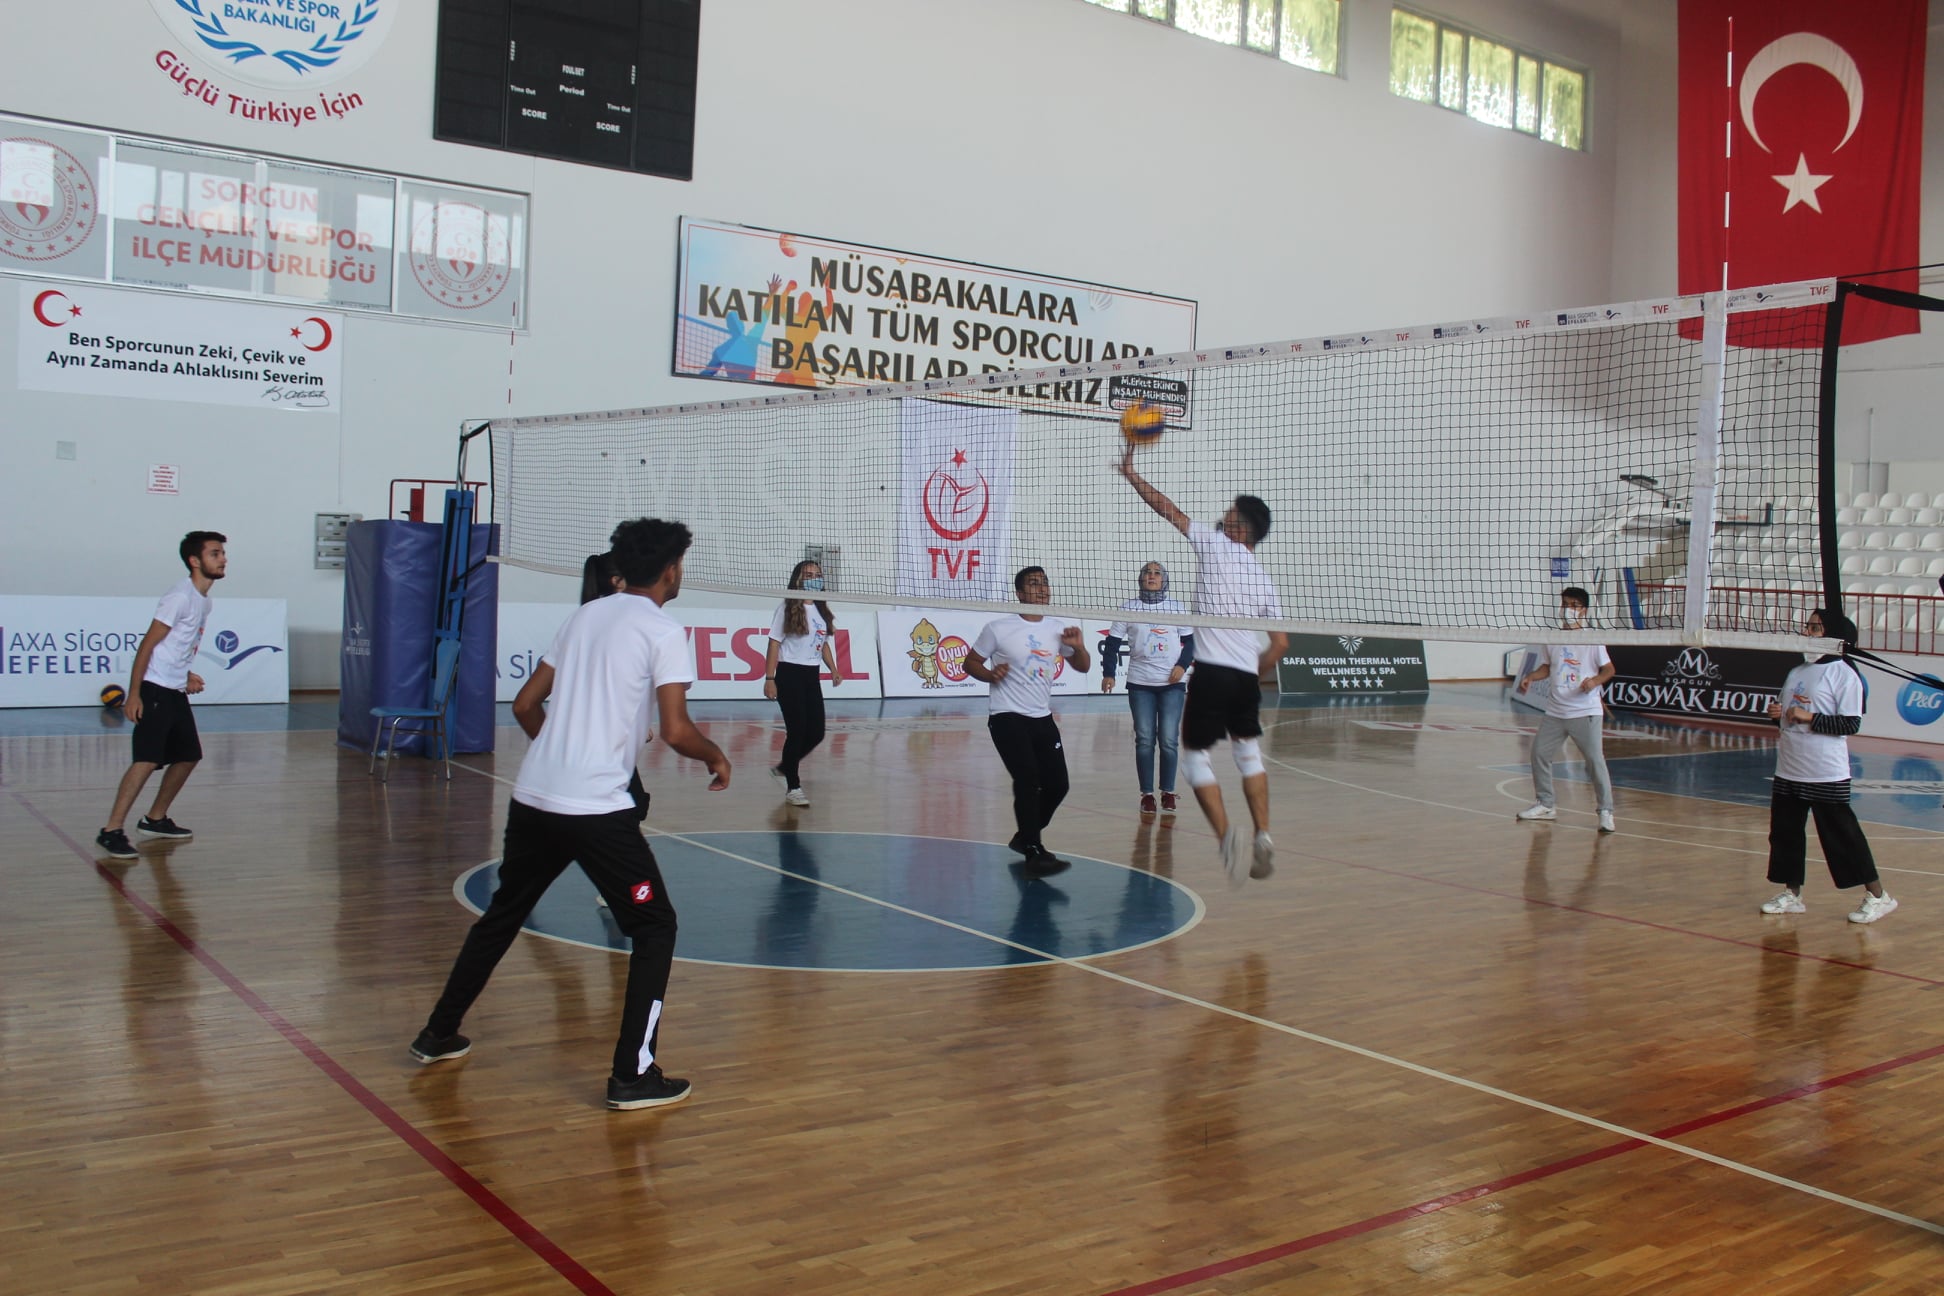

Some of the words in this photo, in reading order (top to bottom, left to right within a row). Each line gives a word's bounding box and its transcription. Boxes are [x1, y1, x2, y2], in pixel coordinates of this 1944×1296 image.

[224, 4, 315, 33] BAKANLIĞI
[298, 0, 340, 20] SPOR
[155, 50, 220, 106] Güçlü
[228, 94, 317, 127] Türkiye
[319, 92, 363, 119] İçin
[559, 84, 585, 96] Period
[522, 108, 547, 120] SCORE
[596, 122, 620, 133] SCORE
[201, 178, 318, 212] SORGUN
[137, 203, 257, 239] GENÇLİK
[266, 218, 298, 243] VE
[305, 224, 374, 253] SPOR
[200, 244, 376, 284] MÜDÜRLÜĞÜ
[810, 253, 1079, 326] MÜSABAKALARA
[1810, 286, 1829, 296] TVF
[698, 284, 853, 336] KATILAN
[867, 303, 939, 347] TÜM
[1652, 305, 1669, 314] TVF
[1515, 320, 1530, 329] TVF
[1396, 333, 1410, 342] TVF
[69, 332, 101, 348] Ben
[105, 335, 194, 357] Sporcunun
[199, 345, 238, 362] Zeki,
[242, 348, 285, 364] Çevik
[288, 354, 306, 366] ve
[1290, 344, 1302, 352] TVF
[1196, 354, 1207, 362] TVF
[47, 350, 85, 369] Aynı
[91, 355, 168, 374] Zamanda
[173, 361, 258, 381] Ahlaklısını
[262, 370, 324, 386] Severim
[928, 548, 980, 580] TVF
[10, 632, 57, 652] AXA
[64, 629, 147, 652] SİGOR
[938, 645, 968, 662] Oyun
[1283, 657, 1306, 665] SAFA
[1308, 657, 1346, 665] SORGUN
[1348, 657, 1391, 665] THERMAL
[1393, 657, 1422, 665] HOTEL
[946, 661, 966, 678] Sko
[1313, 667, 1367, 676] WELLNNESS
[1370, 667, 1377, 675] &
[1379, 667, 1396, 675] SPA
[1665, 676, 1712, 686] SORGUN
[1599, 681, 1709, 713] MISSWAK
[1710, 690, 1779, 715] HOTE
[1906, 690, 1943, 709] P&G
